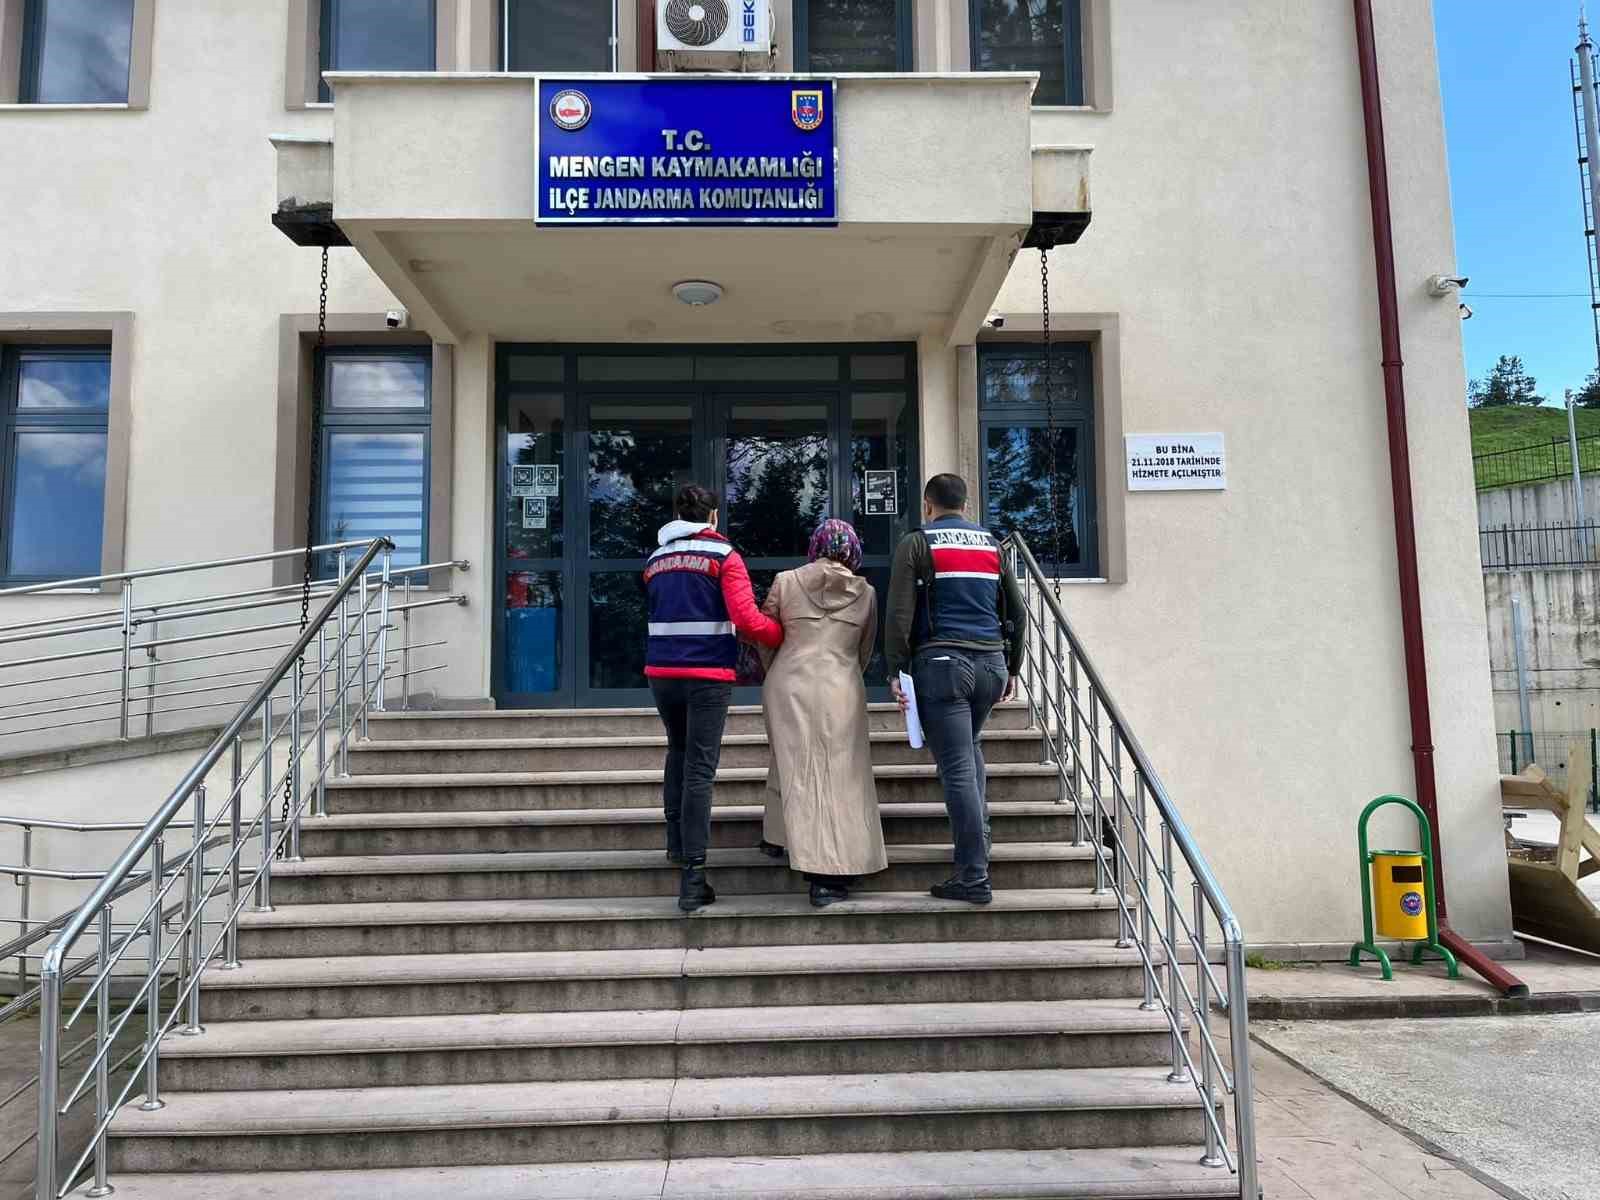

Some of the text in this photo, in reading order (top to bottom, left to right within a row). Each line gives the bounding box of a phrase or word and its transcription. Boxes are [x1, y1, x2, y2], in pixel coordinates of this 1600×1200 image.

[661, 129, 711, 150] T.C.
[549, 150, 822, 178] MENGEN KAYMAKAMLIĞI
[594, 187, 694, 208] JANDARMA
[700, 182, 823, 209] KOMUTANLIĞI
[1155, 444, 1195, 454] BU BİNA
[1131, 457, 1175, 467] 21.11.2018
[1132, 468, 1221, 479] HİZMETE AÇILMIŞTIR
[934, 532, 991, 546] JANDARMA
